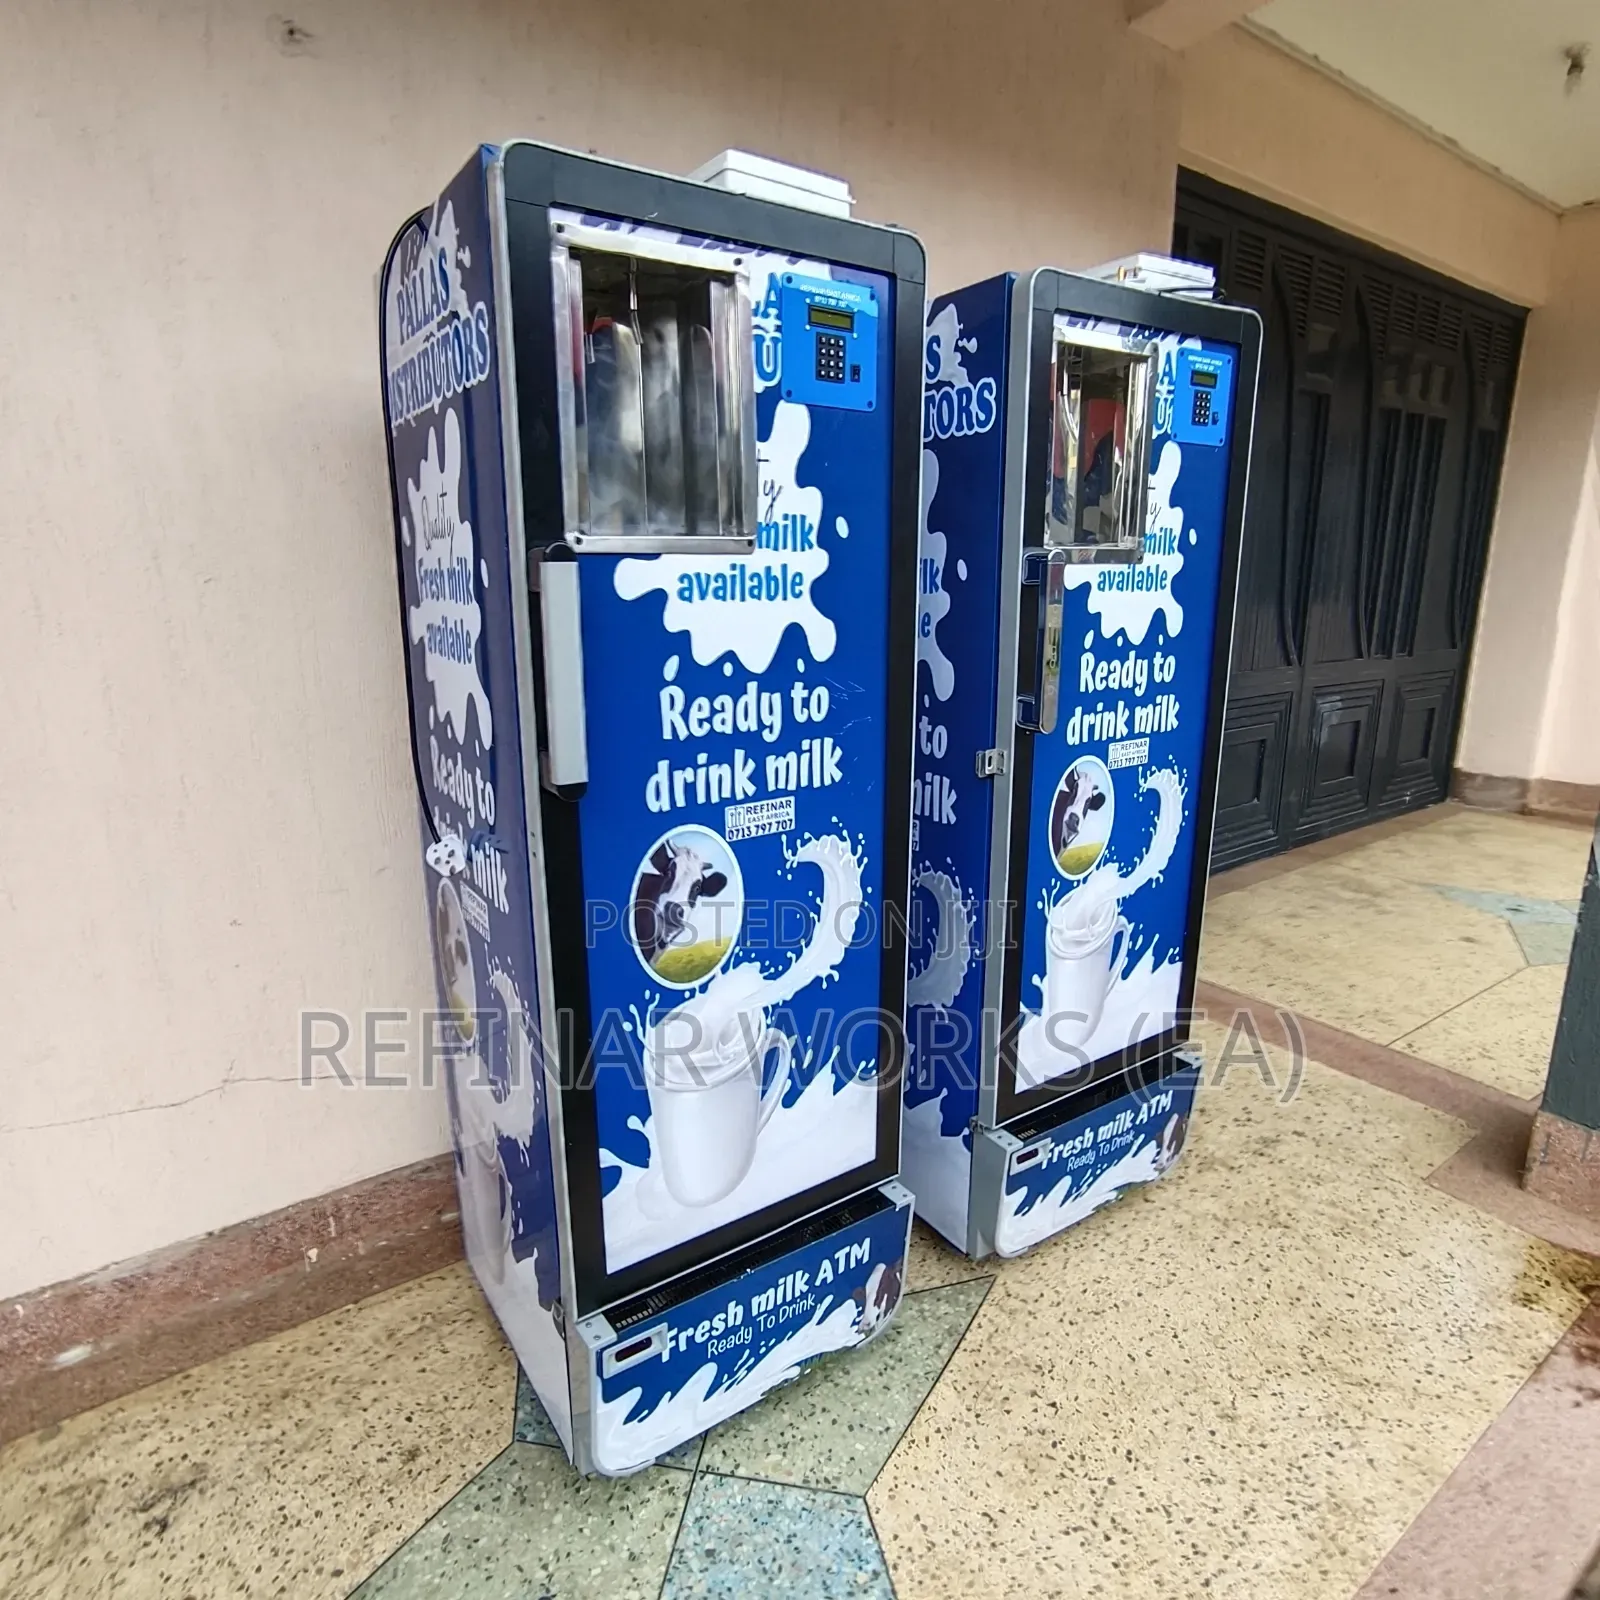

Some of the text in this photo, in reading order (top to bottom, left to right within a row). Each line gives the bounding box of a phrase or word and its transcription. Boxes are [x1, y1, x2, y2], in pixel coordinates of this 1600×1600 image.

[397, 247, 451, 344] PALLAS
[421, 480, 455, 562] Quality
[757, 513, 814, 552] milk
[418, 556, 473, 605] Fresh milk
[677, 562, 804, 603] available
[1097, 563, 1168, 592] available
[426, 615, 473, 665] available
[1079, 649, 1176, 697] Ready to
[659, 680, 830, 743] Ready to
[1066, 694, 1180, 746] drink milk
[1108, 758, 1123, 769] 0713
[1136, 754, 1147, 764] 707
[1120, 740, 1148, 751] REFINAR
[430, 735, 496, 829] Ready to
[645, 736, 843, 813] drink milk
[728, 818, 793, 840] 0713 797 707
[745, 799, 792, 816] REFINAR
[747, 810, 790, 824] EAST AFRICA
[471, 841, 510, 914] milk
[1041, 1089, 1174, 1170] Fresh milk ATM
[1066, 1129, 1136, 1172] Ready To Drink
[660, 1237, 871, 1363] Fresh milk ATM
[707, 1291, 817, 1359] Ready To Drink
